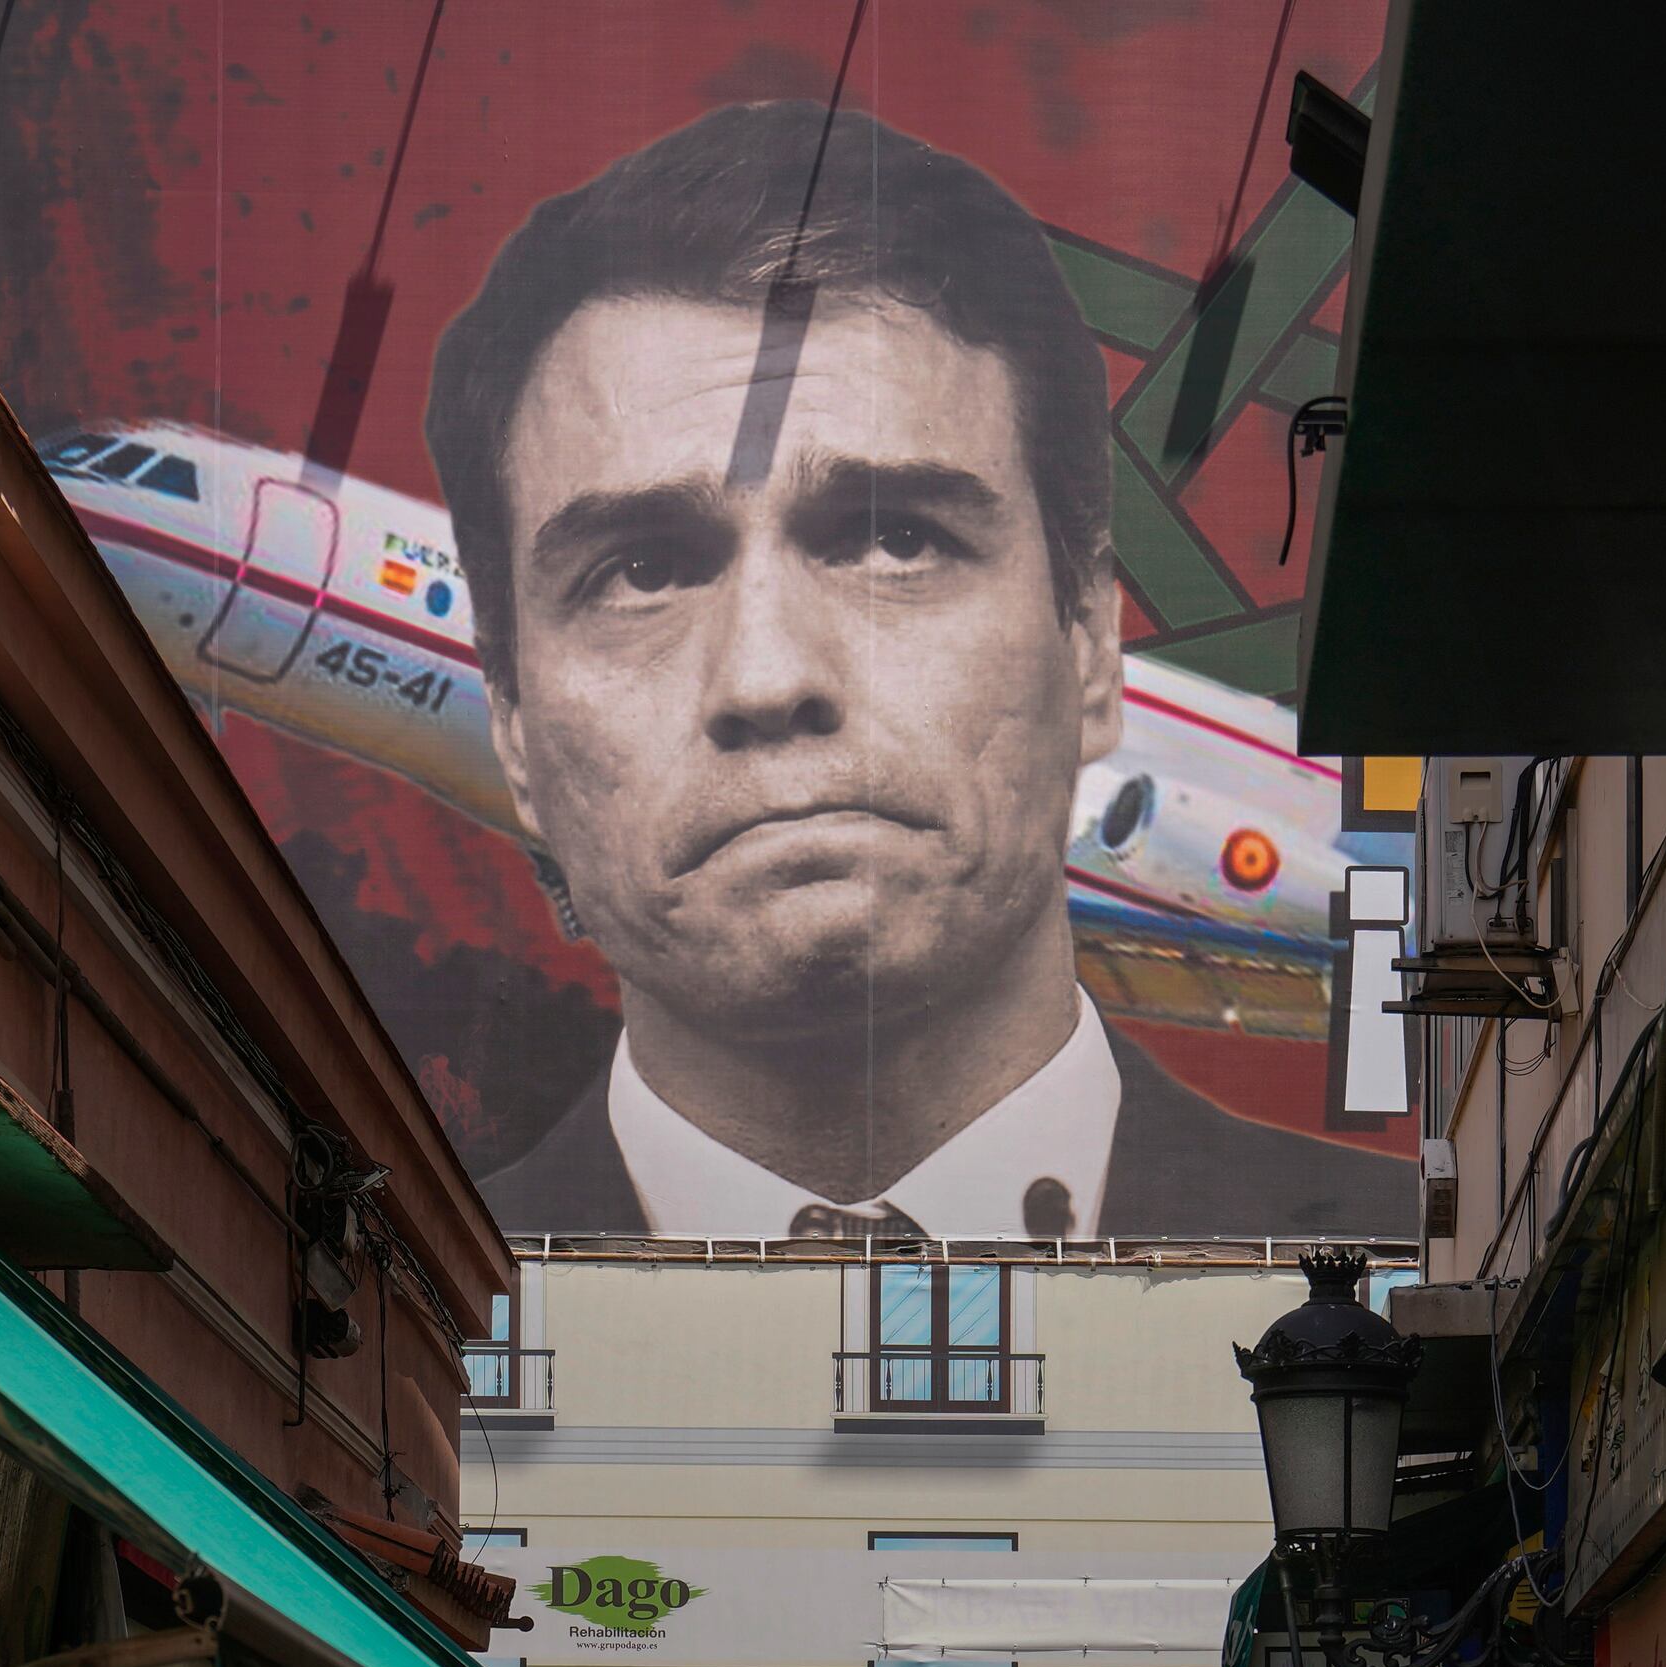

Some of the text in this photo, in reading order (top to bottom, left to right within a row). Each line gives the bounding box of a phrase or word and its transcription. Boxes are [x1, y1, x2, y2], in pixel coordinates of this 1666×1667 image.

[314, 640, 450, 715] 45-41
[545, 1566, 691, 1621] Dago
[569, 1626, 666, 1639] Rehabilitación
[576, 1641, 658, 1651] www.grupodago.es
